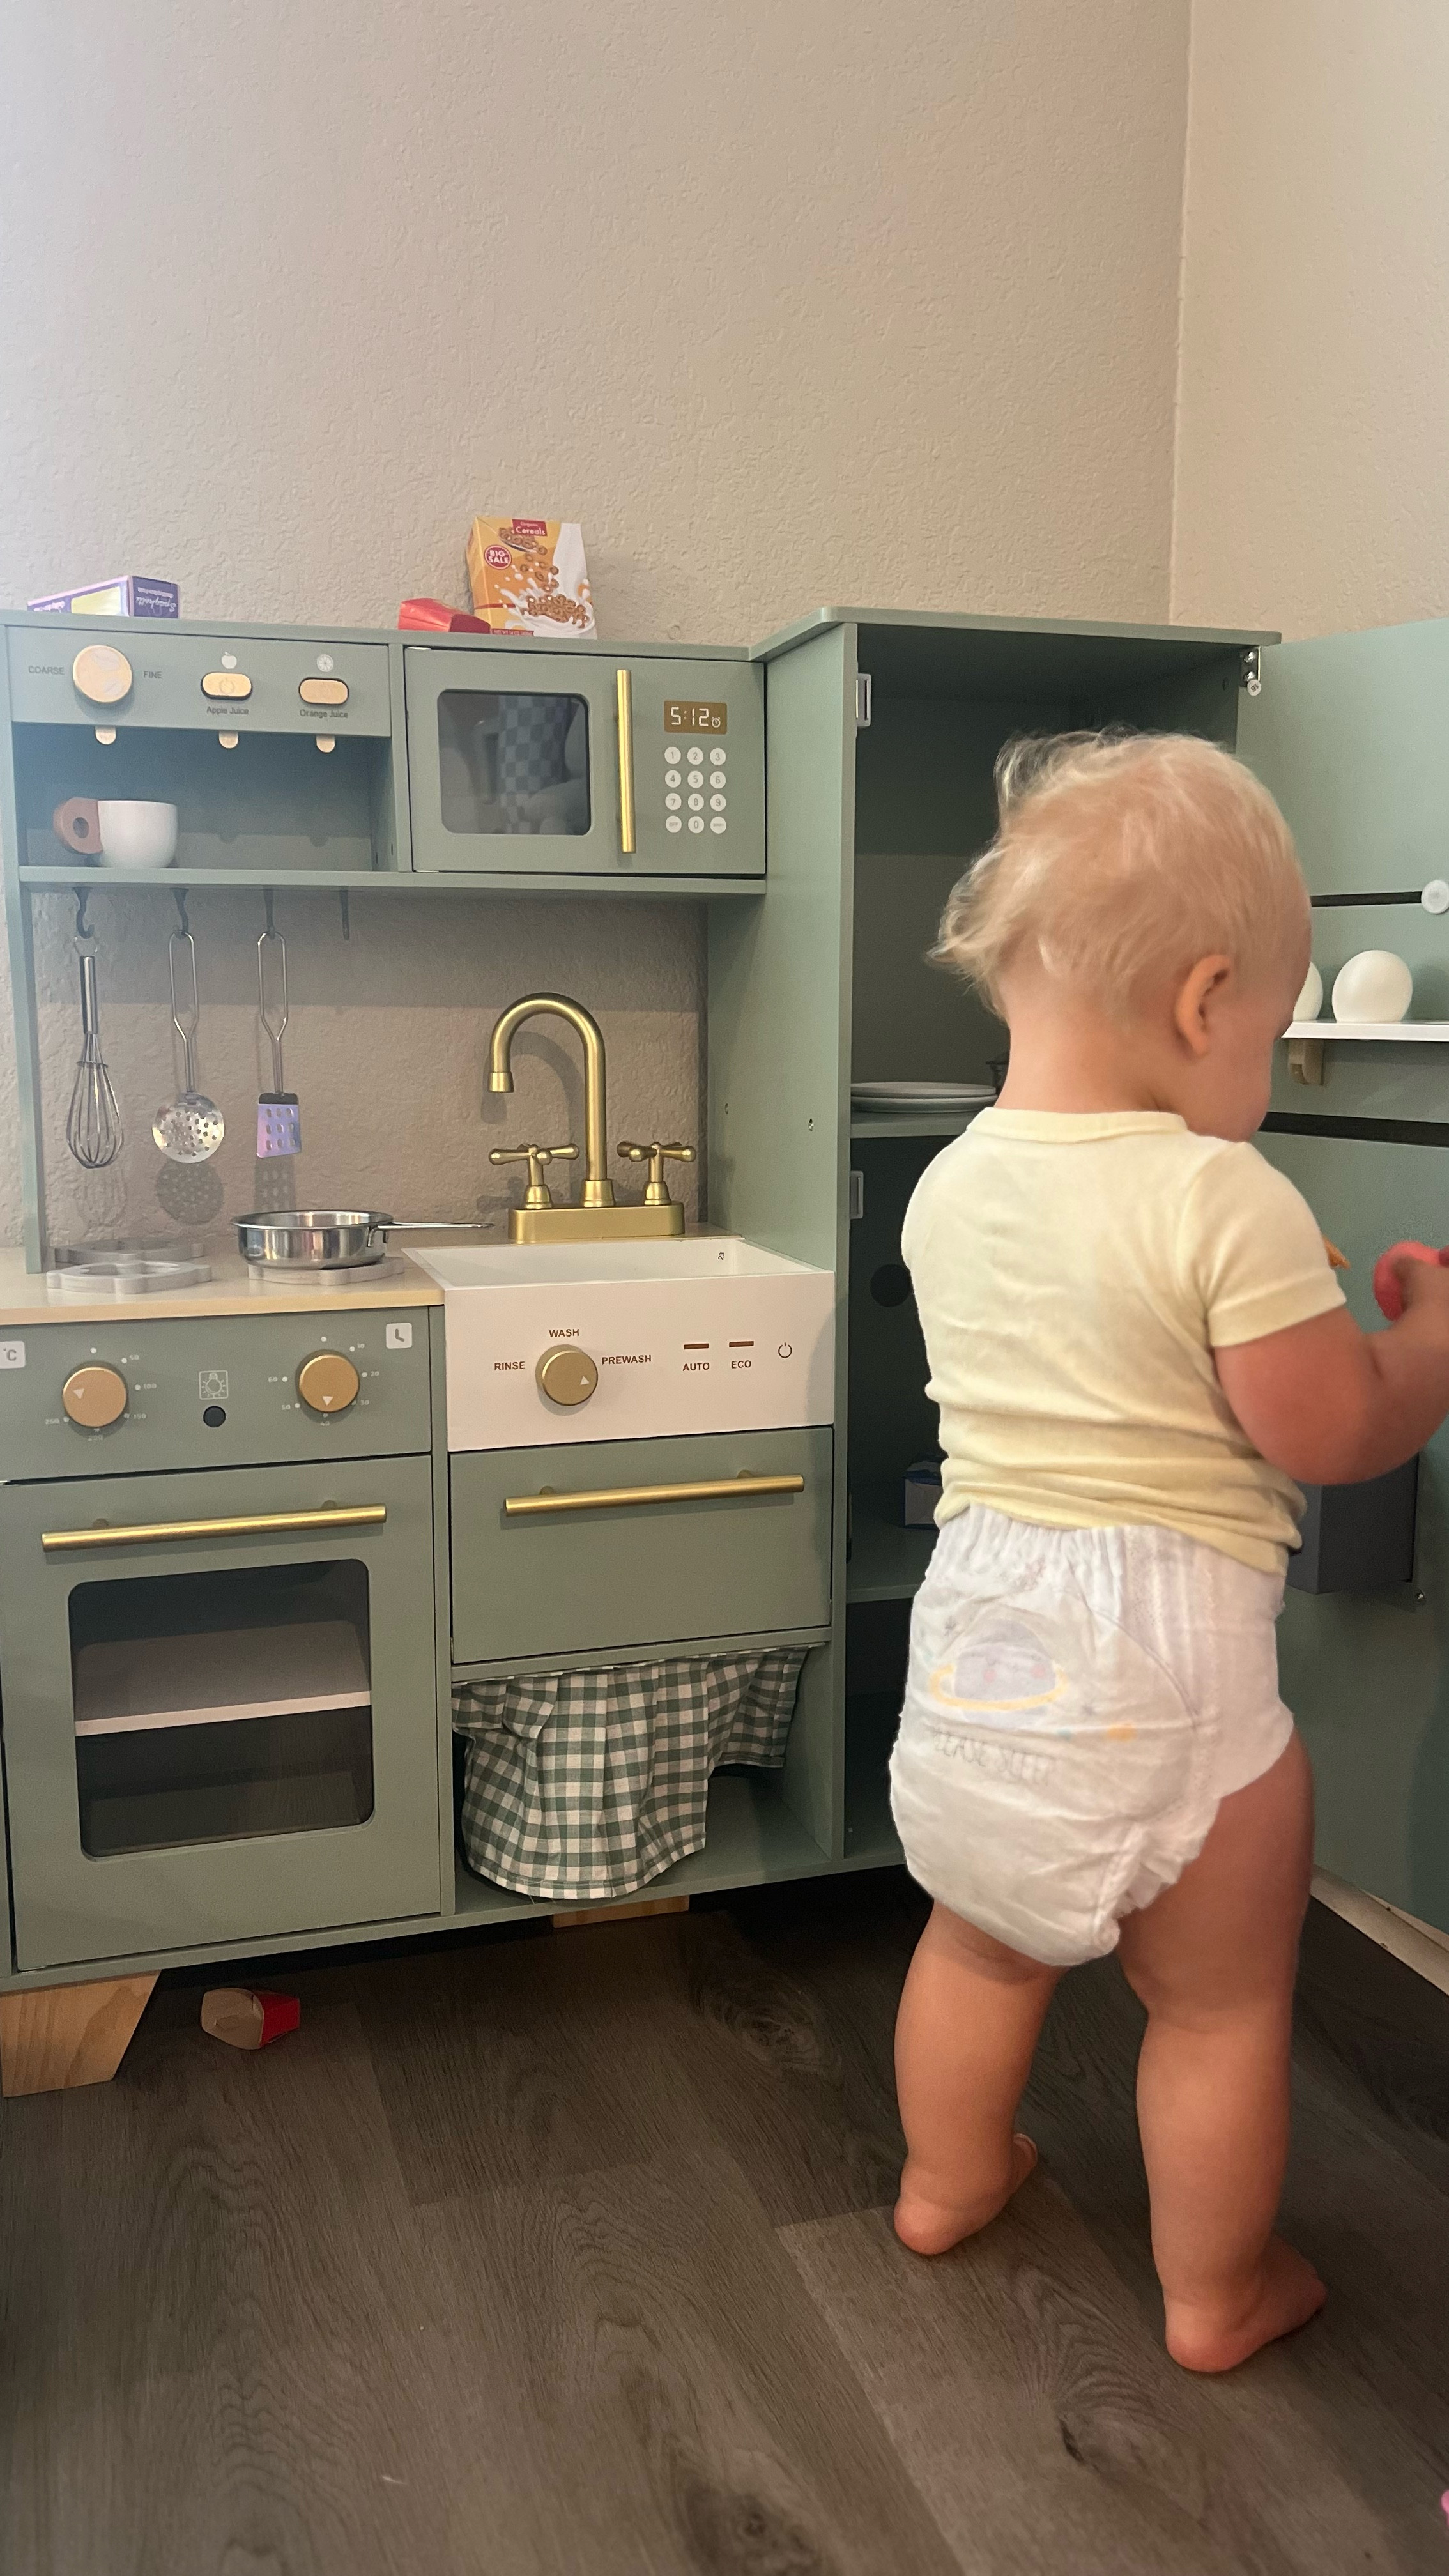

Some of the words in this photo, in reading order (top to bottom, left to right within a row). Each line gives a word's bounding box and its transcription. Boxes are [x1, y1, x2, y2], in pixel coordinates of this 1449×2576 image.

[516, 526, 546, 535] Cereals
[488, 556, 509, 564] SALE
[29, 666, 65, 675] COARSE
[206, 706, 227, 715] Apple
[229, 707, 249, 715] Juice
[300, 709, 327, 718] Orange
[671, 707, 709, 726] 5:12
[671, 751, 675, 760] 1
[693, 752, 698, 760] 2
[716, 753, 720, 761] 3
[670, 774, 675, 783] 4
[693, 775, 698, 783] 5
[716, 776, 721, 784] 6
[693, 798, 698, 806] 8
[716, 799, 721, 807] 9
[694, 820, 698, 829] 0
[549, 1328, 579, 1338] WASH
[601, 1354, 652, 1365] PREWASH
[494, 1361, 526, 1371] RINSE
[682, 1362, 710, 1372] AUTO
[731, 1360, 752, 1369] ECO
